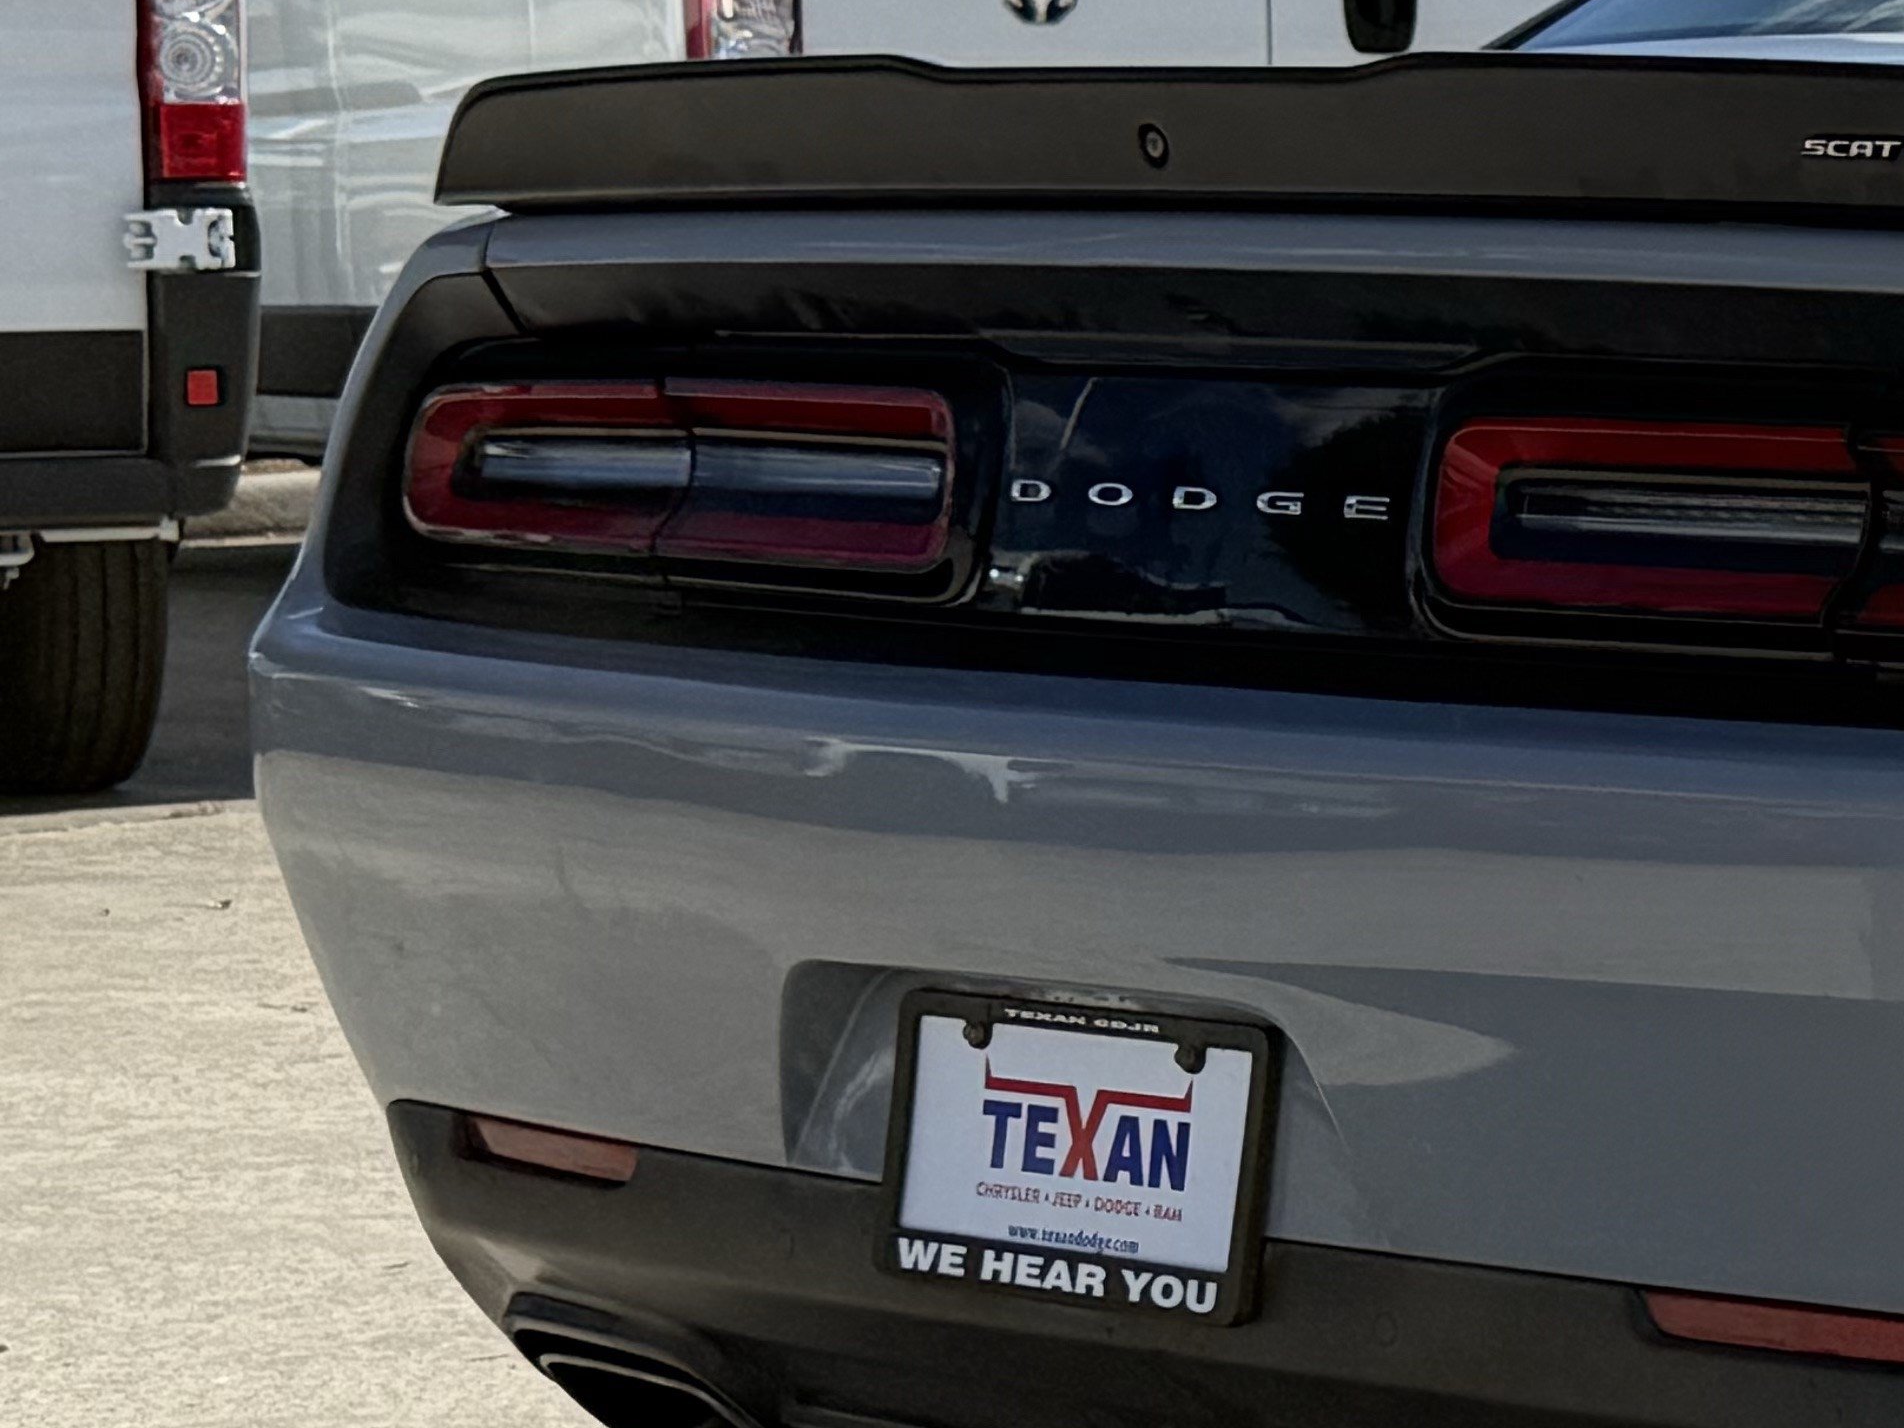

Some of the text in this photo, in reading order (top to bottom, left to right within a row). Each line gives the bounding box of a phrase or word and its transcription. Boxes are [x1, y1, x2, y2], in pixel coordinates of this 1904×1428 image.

[1801, 138, 1902, 158] SCAT
[1010, 478, 1391, 521] DODGE
[1003, 1008, 1087, 1025] TEXAN
[982, 1056, 1193, 1192] TEXAN
[976, 1181, 1183, 1222] CHRYSLER JEEP DODGE RAM
[896, 1237, 1218, 1314] WE HEAR YOU
